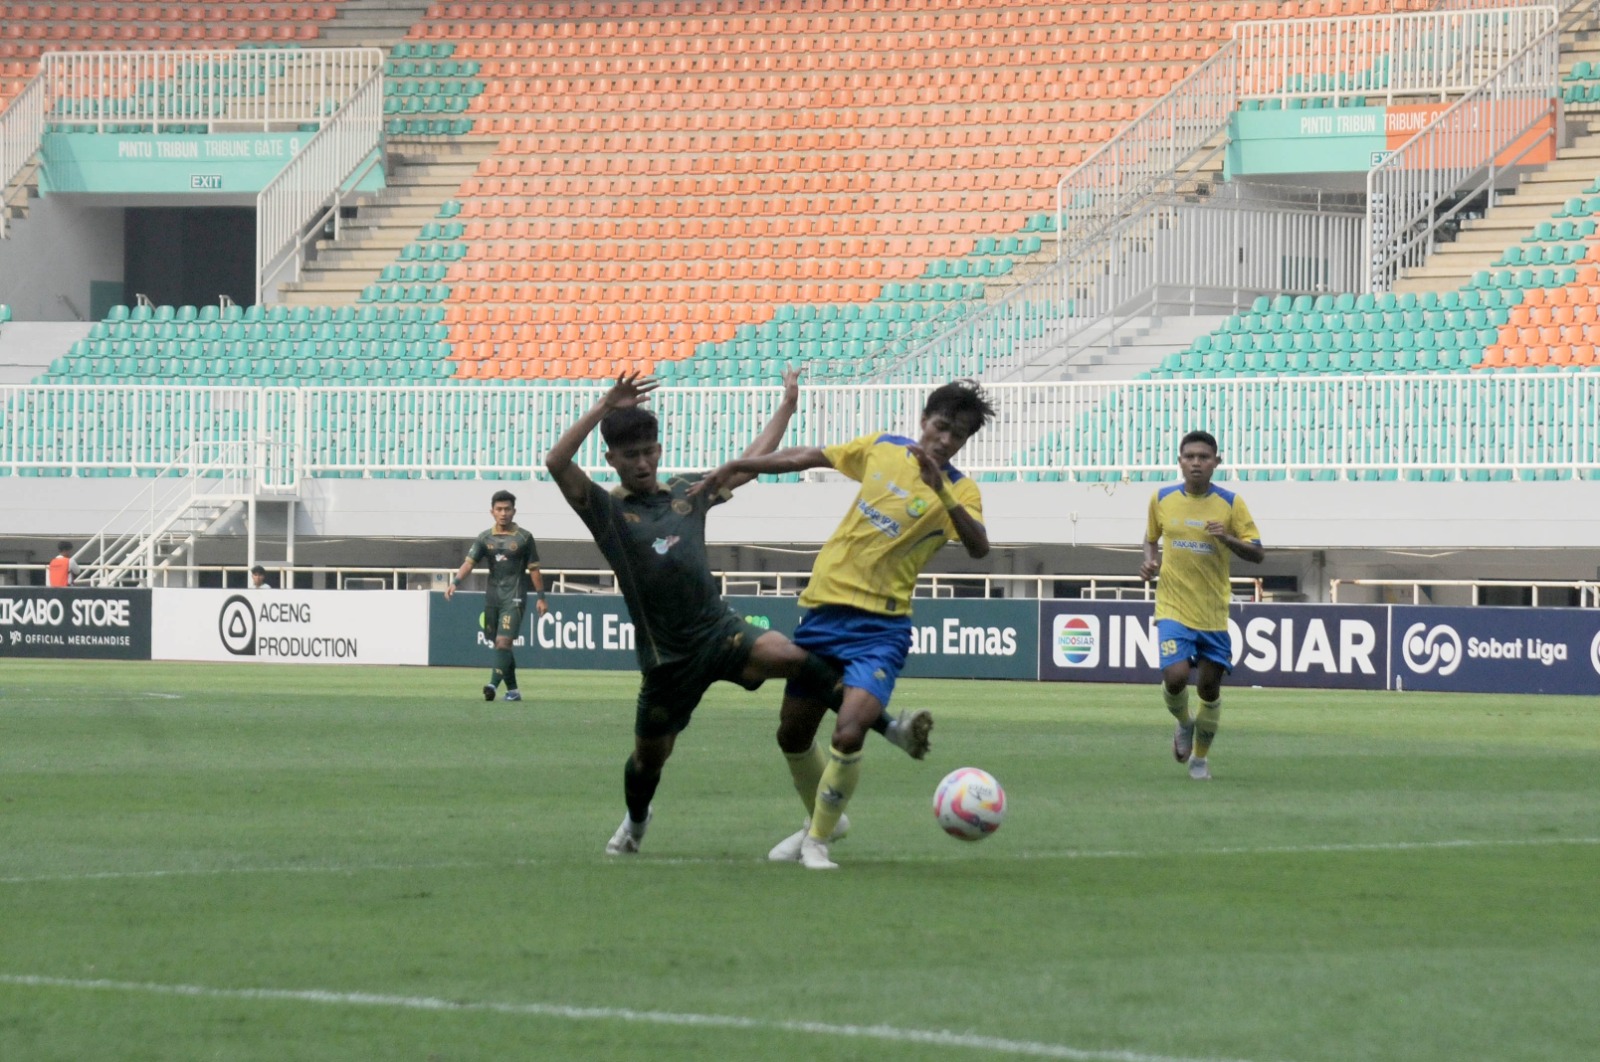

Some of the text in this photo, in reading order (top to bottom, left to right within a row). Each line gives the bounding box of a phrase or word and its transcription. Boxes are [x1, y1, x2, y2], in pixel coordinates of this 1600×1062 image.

[1300, 115, 1333, 135] PINTU
[1336, 113, 1376, 133] TRIBUN
[1382, 110, 1428, 131] TRIBUNE
[118, 137, 299, 158] PINTU TRIBUN TRIBUNE GATE 9
[191, 175, 221, 188] EXIT
[0, 597, 131, 627] IKABO STORE
[258, 602, 311, 623] ACENG
[25, 634, 65, 646] OFFICIAL
[68, 635, 131, 647] MERCHANDISE
[537, 610, 595, 650] Cicil
[943, 618, 1017, 656] Emas
[1058, 636, 1095, 646] INDOSIAR
[258, 637, 358, 658] PRODUCTION
[1108, 614, 1377, 675] INSIAR
[1467, 636, 1568, 666] Sobat Liga
